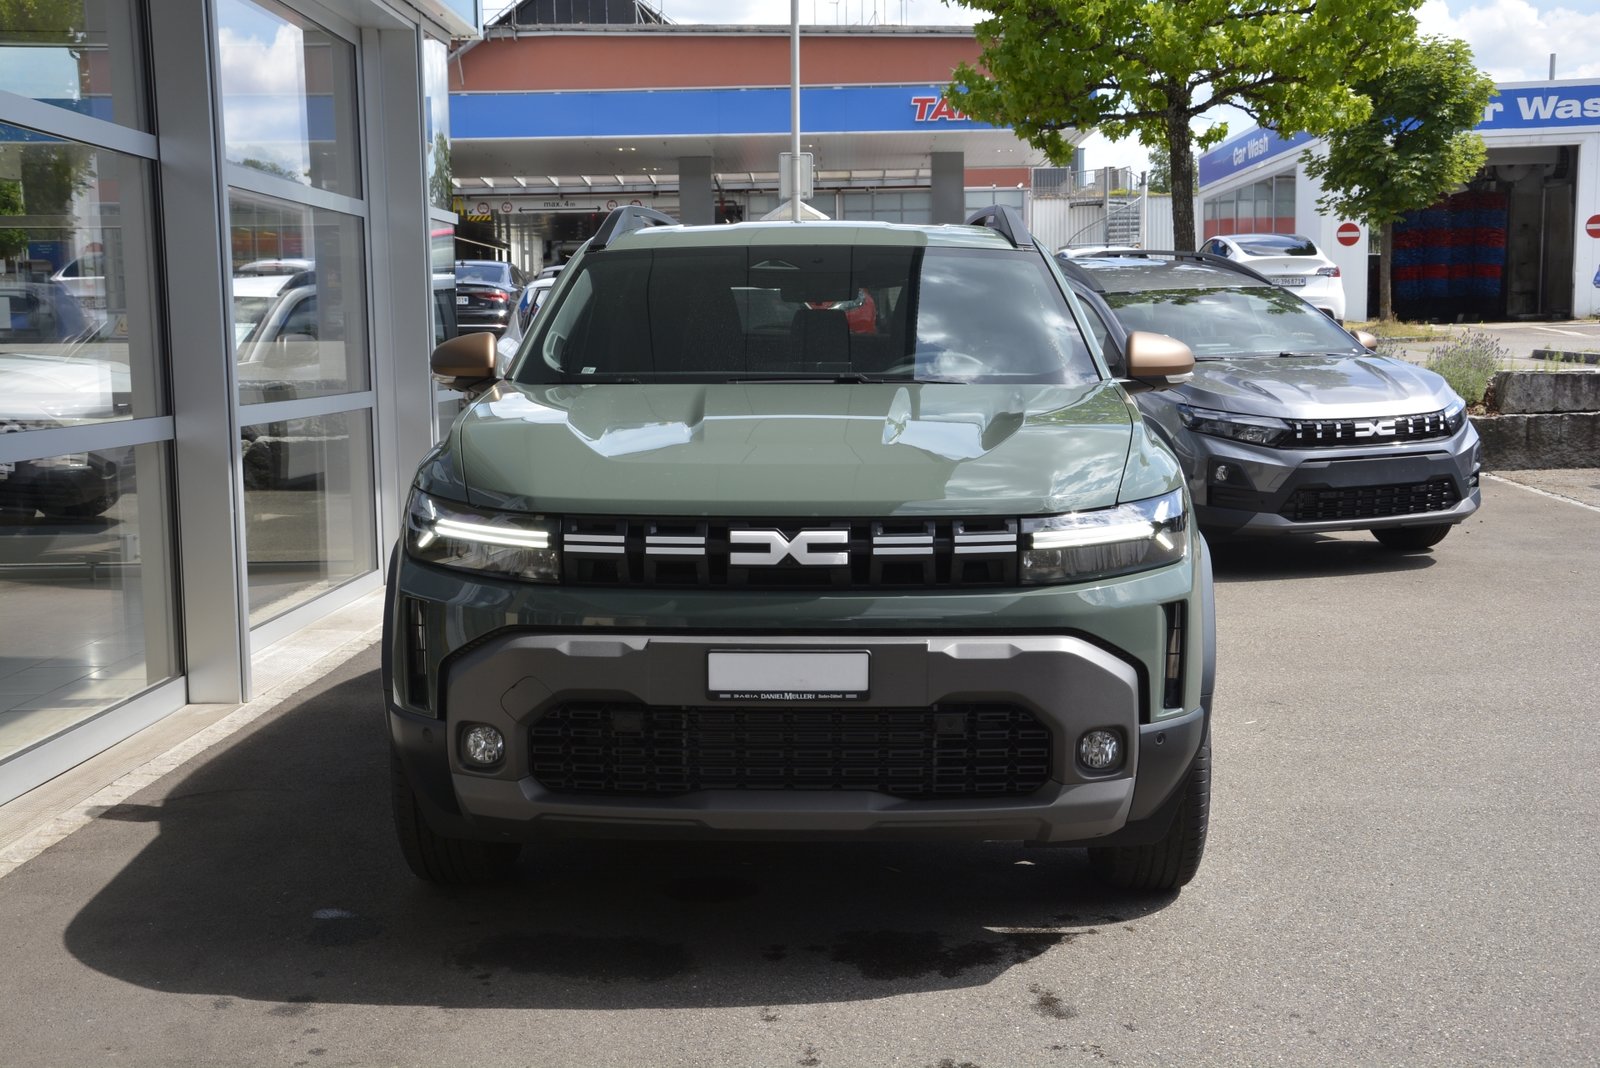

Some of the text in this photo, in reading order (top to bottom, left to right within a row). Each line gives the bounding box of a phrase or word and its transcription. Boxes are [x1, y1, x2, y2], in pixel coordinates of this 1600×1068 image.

[911, 96, 972, 121] TA
[1516, 95, 1600, 120] Was
[1233, 133, 1269, 167] Car Wash
